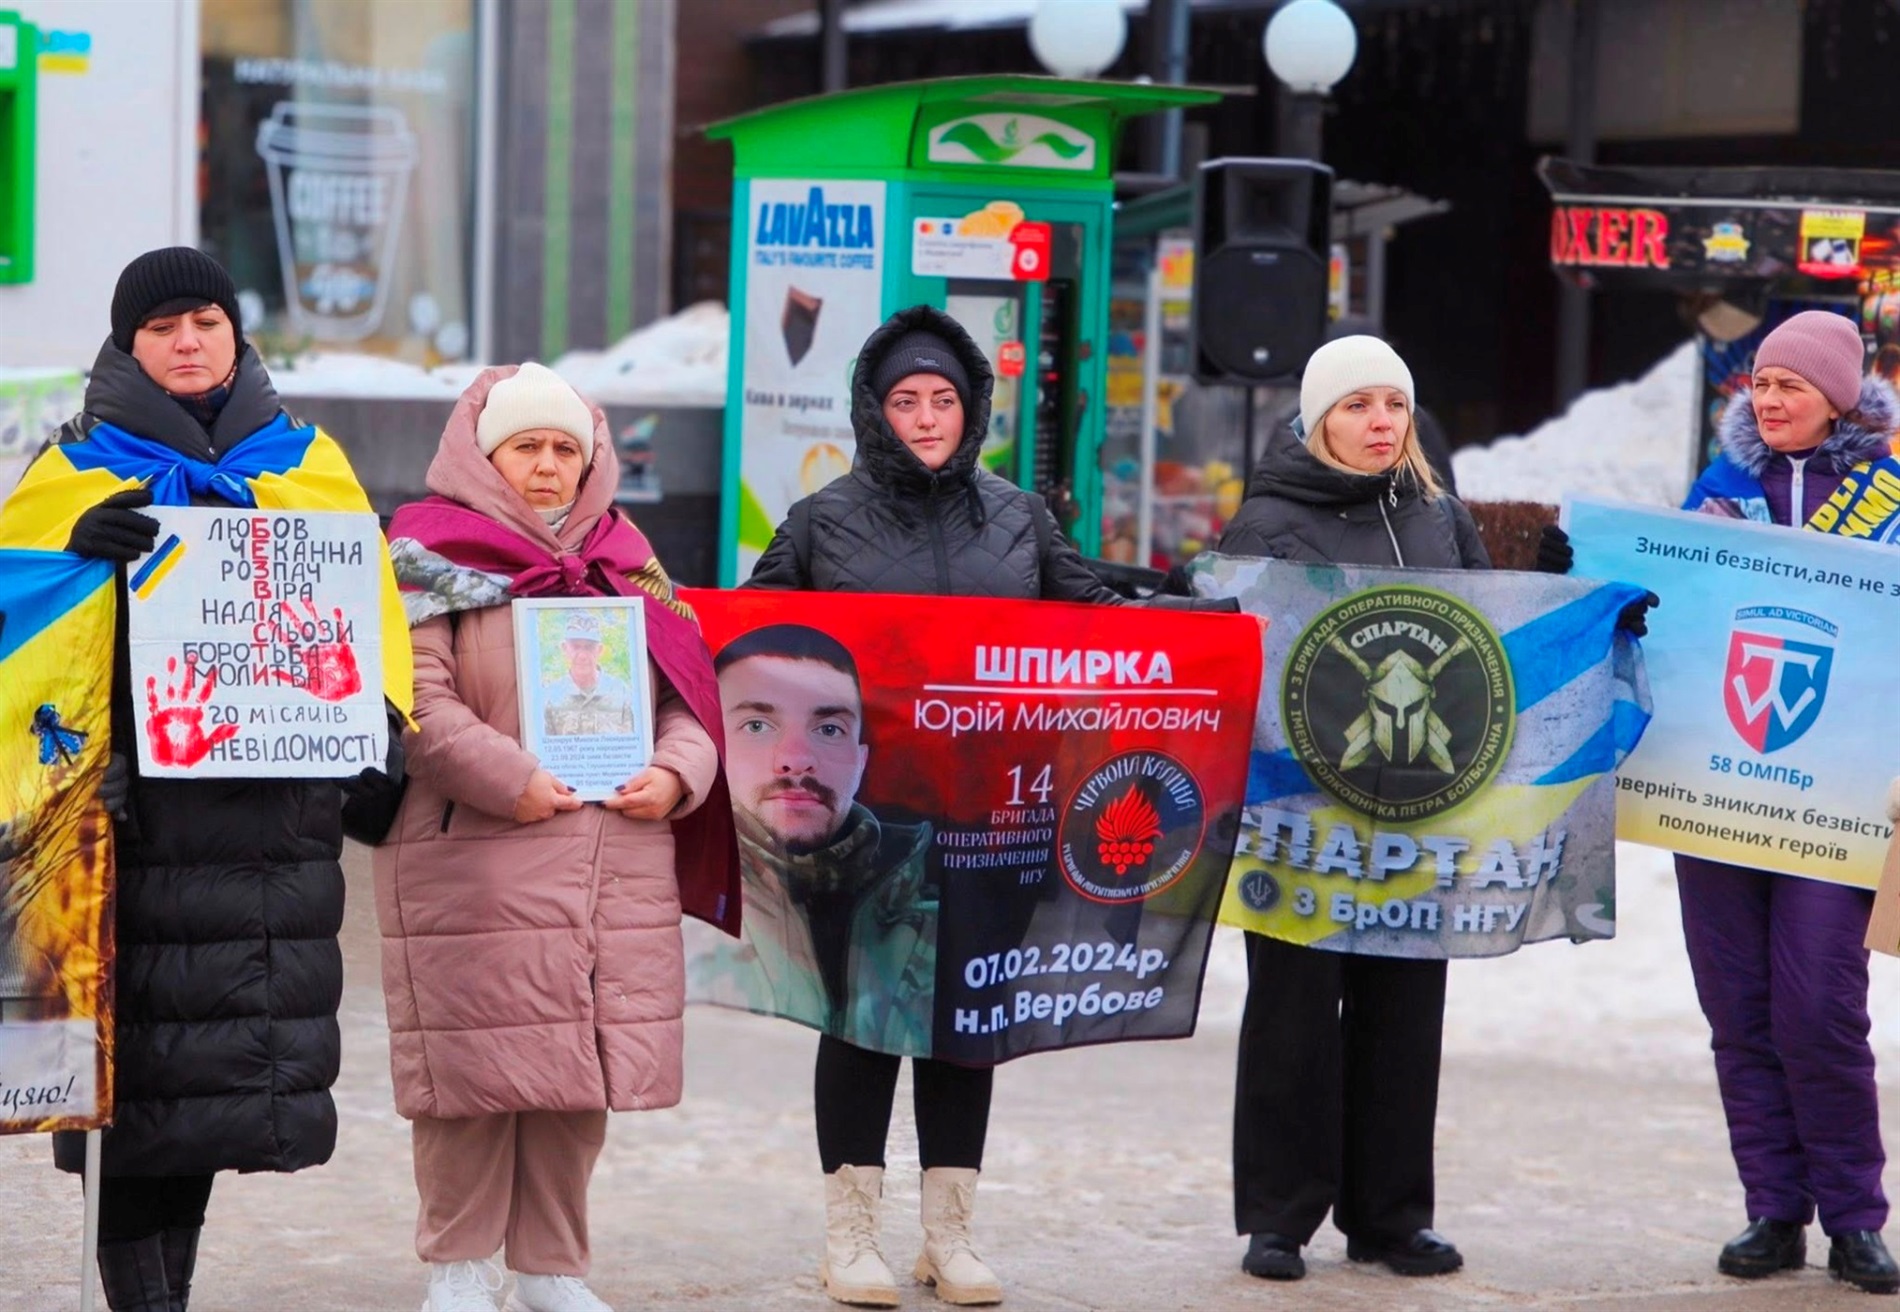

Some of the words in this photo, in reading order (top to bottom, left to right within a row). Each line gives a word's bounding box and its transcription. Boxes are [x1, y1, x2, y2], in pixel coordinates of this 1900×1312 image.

[757, 186, 873, 248] LAVAZZA
[208, 517, 309, 541] ЛЮБОВ
[230, 539, 362, 565] ЧЕКАННЯ
[1635, 537, 1710, 563] Зниклі
[1859, 579, 1885, 594] не
[221, 560, 321, 583] РОЗПАЧ
[254, 580, 313, 601] ВІРА
[202, 599, 282, 625] НАДІЯ
[1768, 608, 1783, 618] AD
[1785, 609, 1838, 635] VICTORIAM
[253, 620, 354, 643] СЛЬОЗИ
[1296, 617, 1338, 674] БРИГАДА
[1338, 594, 1449, 620] ОПЕРАТИВНОГО
[1449, 609, 1505, 698] ПРИЗНАЧЕННЯ
[1350, 621, 1448, 656] СПАРТАН
[183, 642, 320, 664] БОРОТЬБА
[975, 645, 1174, 685] ШПИРКА
[192, 662, 322, 689] МОЛИТВА
[209, 705, 239, 724] 20
[914, 699, 1004, 738] Юрій
[1013, 702, 1222, 733] Михайлович
[1291, 709, 1316, 758] ІМЕНІ
[1400, 796, 1445, 817] ПЕТРА
[1446, 722, 1504, 801] БОЛБОЧАНА
[1709, 755, 1732, 774] 58
[1737, 760, 1814, 791] ОМПБр
[1005, 764, 1054, 805] 14
[1073, 755, 1141, 812] ЧЕРВОНА
[1142, 756, 1198, 812] КАЛИНА
[991, 808, 1056, 825] БРИГАДА
[1702, 793, 1796, 822] зниклих
[936, 828, 1053, 848] ОПЕРАТИВНОГО
[1658, 813, 1773, 848] полонених
[1779, 836, 1849, 862] героїв
[943, 848, 1049, 869] ПРИЗНАЧЕННЯ
[1019, 868, 1047, 885] НГУ
[1330, 892, 1440, 931] БрОП
[1453, 901, 1528, 932] НГУ
[964, 942, 1169, 989] 07.02.2024р.
[1014, 982, 1164, 1026] Вербове
